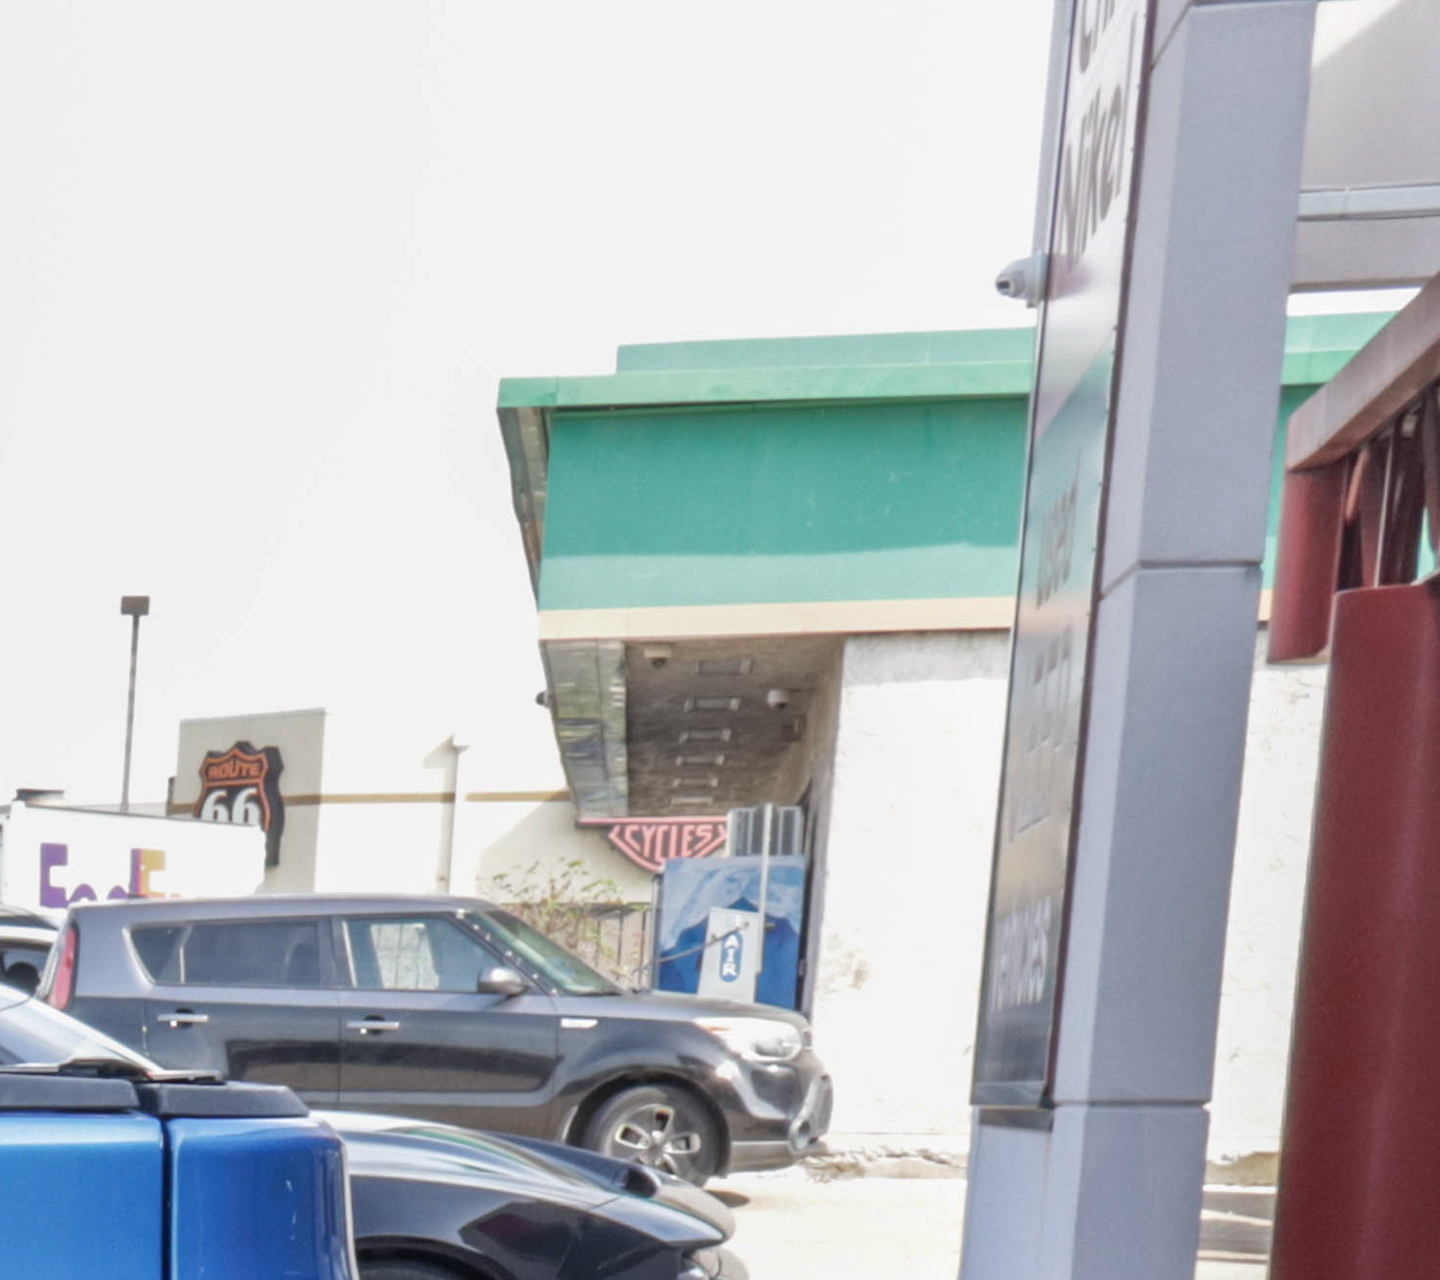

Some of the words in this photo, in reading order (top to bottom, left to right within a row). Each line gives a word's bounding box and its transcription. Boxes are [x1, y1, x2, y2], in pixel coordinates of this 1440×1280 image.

[207, 757, 261, 779] ROUTE
[201, 787, 261, 826] 66
[624, 823, 715, 863] CYCLES
[722, 934, 740, 977] AIR
